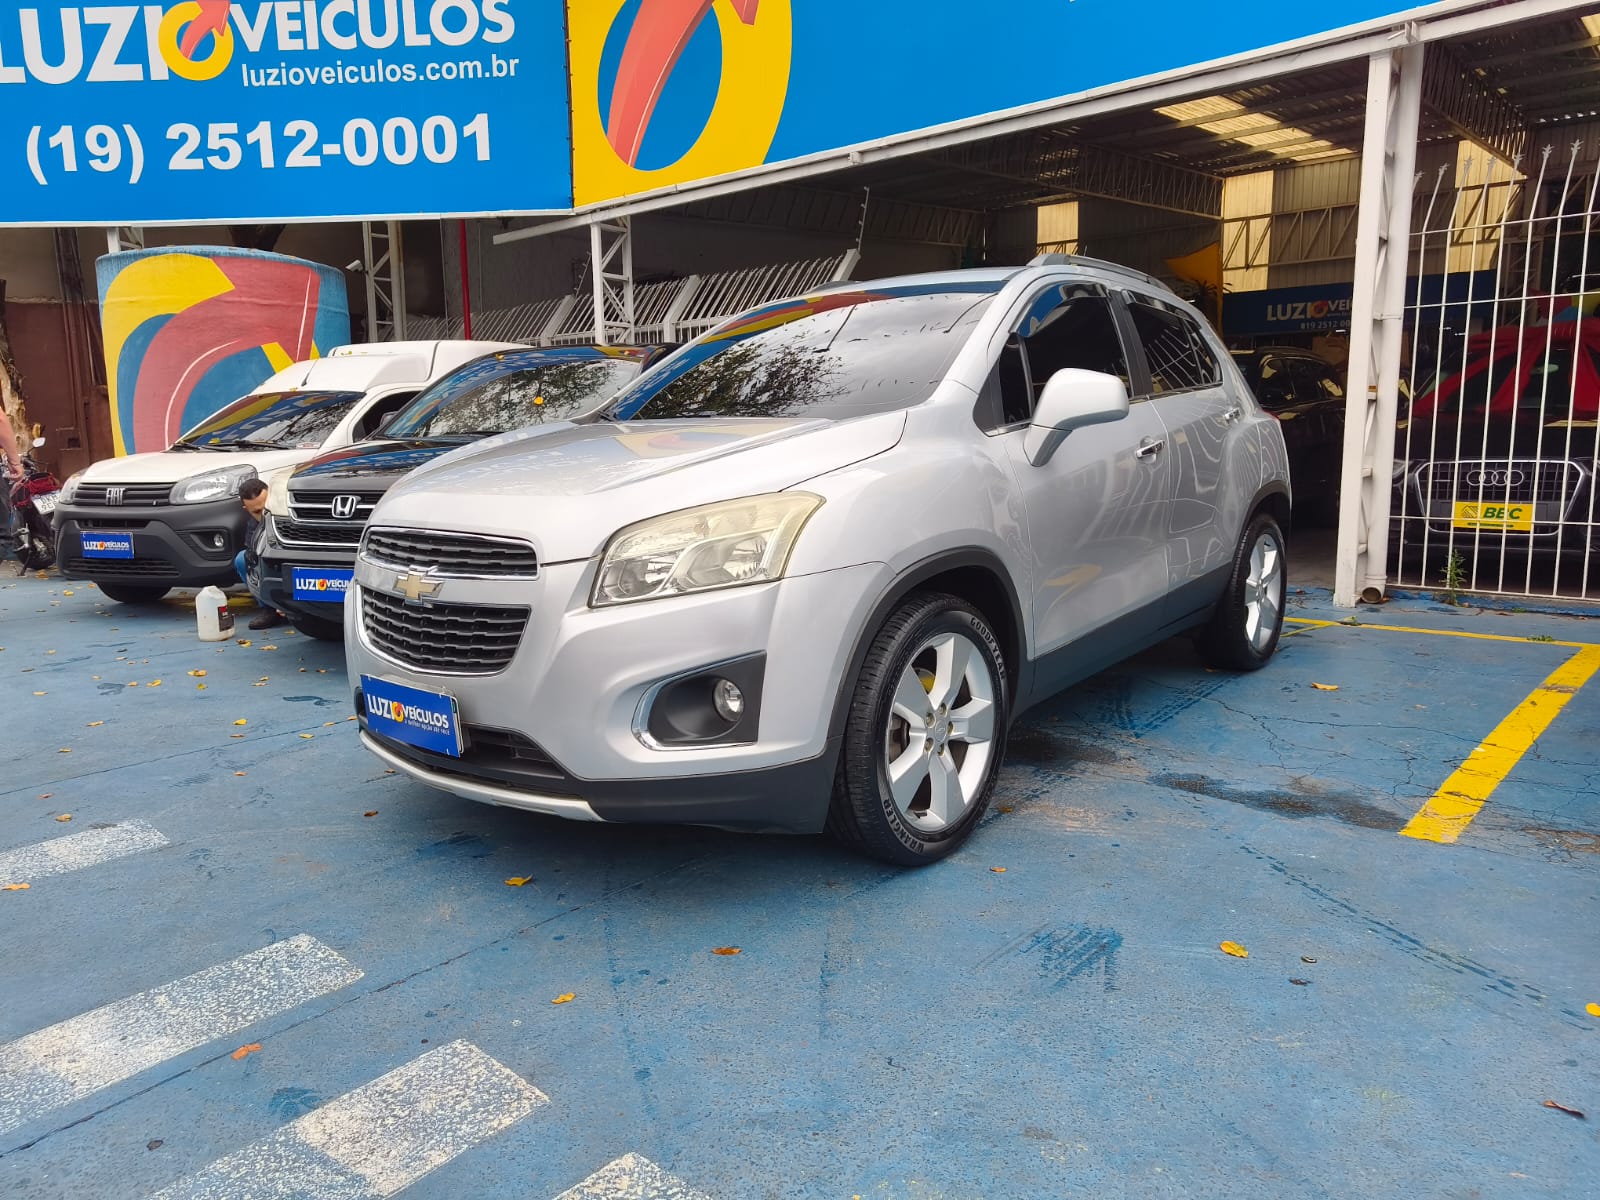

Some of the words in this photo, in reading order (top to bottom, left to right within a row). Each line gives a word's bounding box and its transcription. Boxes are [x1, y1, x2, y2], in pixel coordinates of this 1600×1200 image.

[241, 54, 519, 87] luzioveiculos.com.br
[26, 124, 144, 185] (19)
[166, 113, 490, 170] 2512-0001
[105, 487, 126, 506] FIAT
[970, 616, 1006, 681] GOODYEAR
[883, 798, 925, 854] WRANGLER
